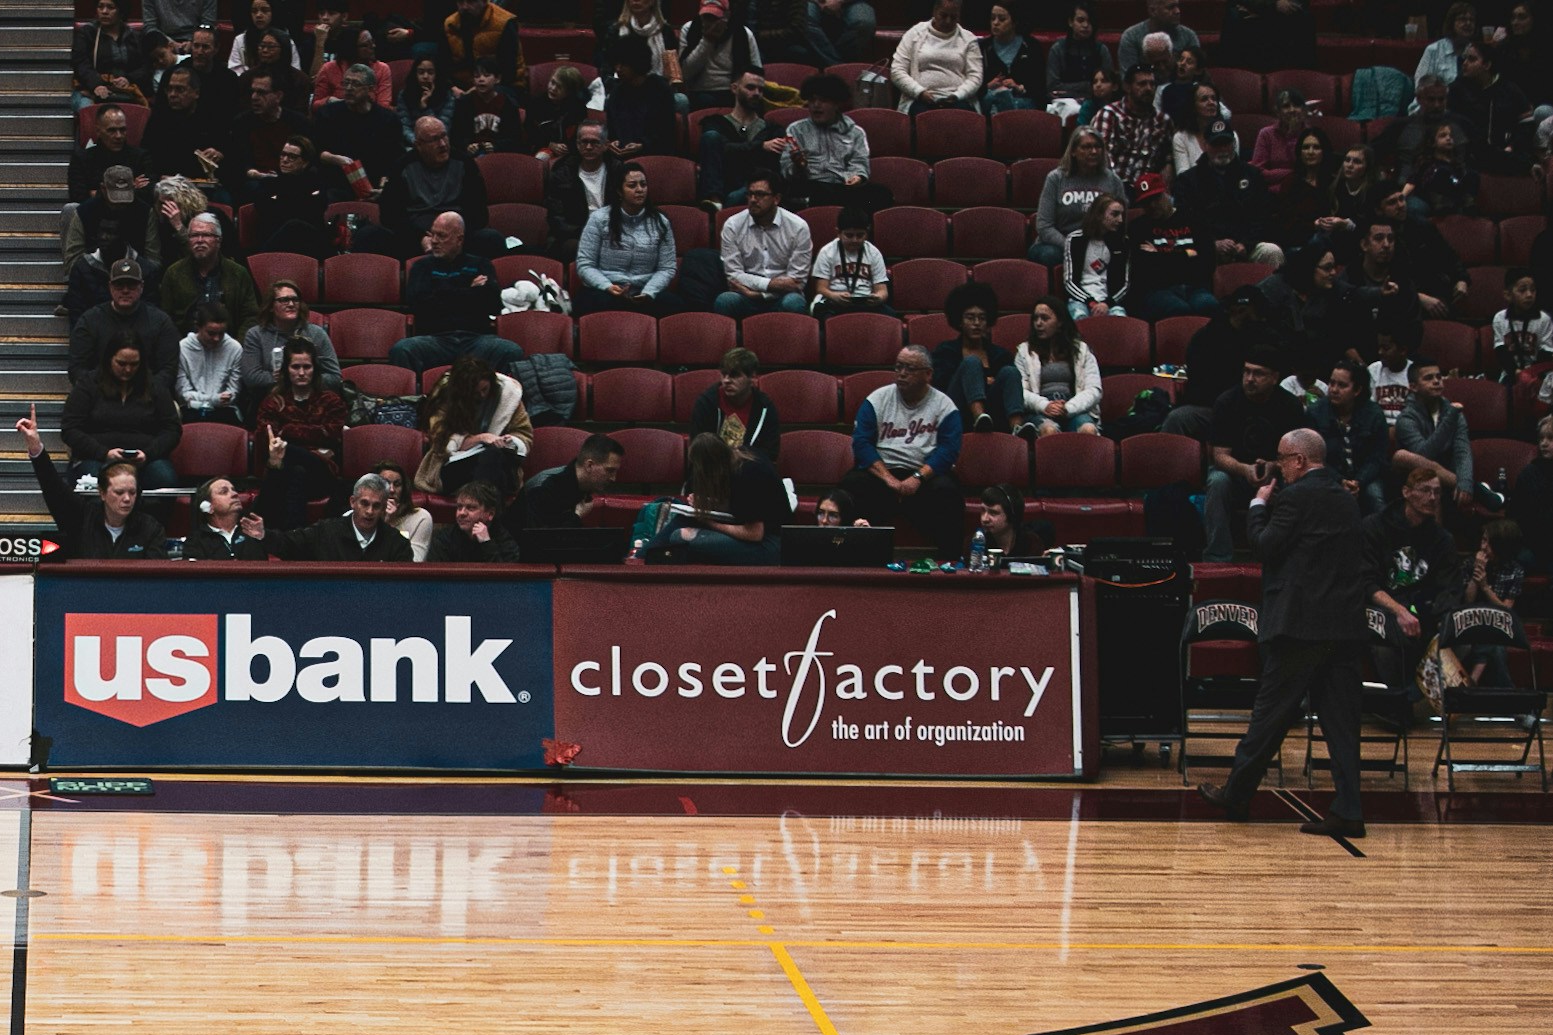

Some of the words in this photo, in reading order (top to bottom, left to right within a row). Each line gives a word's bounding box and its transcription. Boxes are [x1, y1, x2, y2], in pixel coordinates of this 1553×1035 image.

[1061, 190, 1100, 205] OMA
[1196, 603, 1259, 636] DENVER
[1452, 607, 1514, 640] DENVER
[831, 716, 859, 740] the
[864, 720, 889, 740] art
[894, 716, 912, 741] of
[917, 717, 1025, 747] organization
